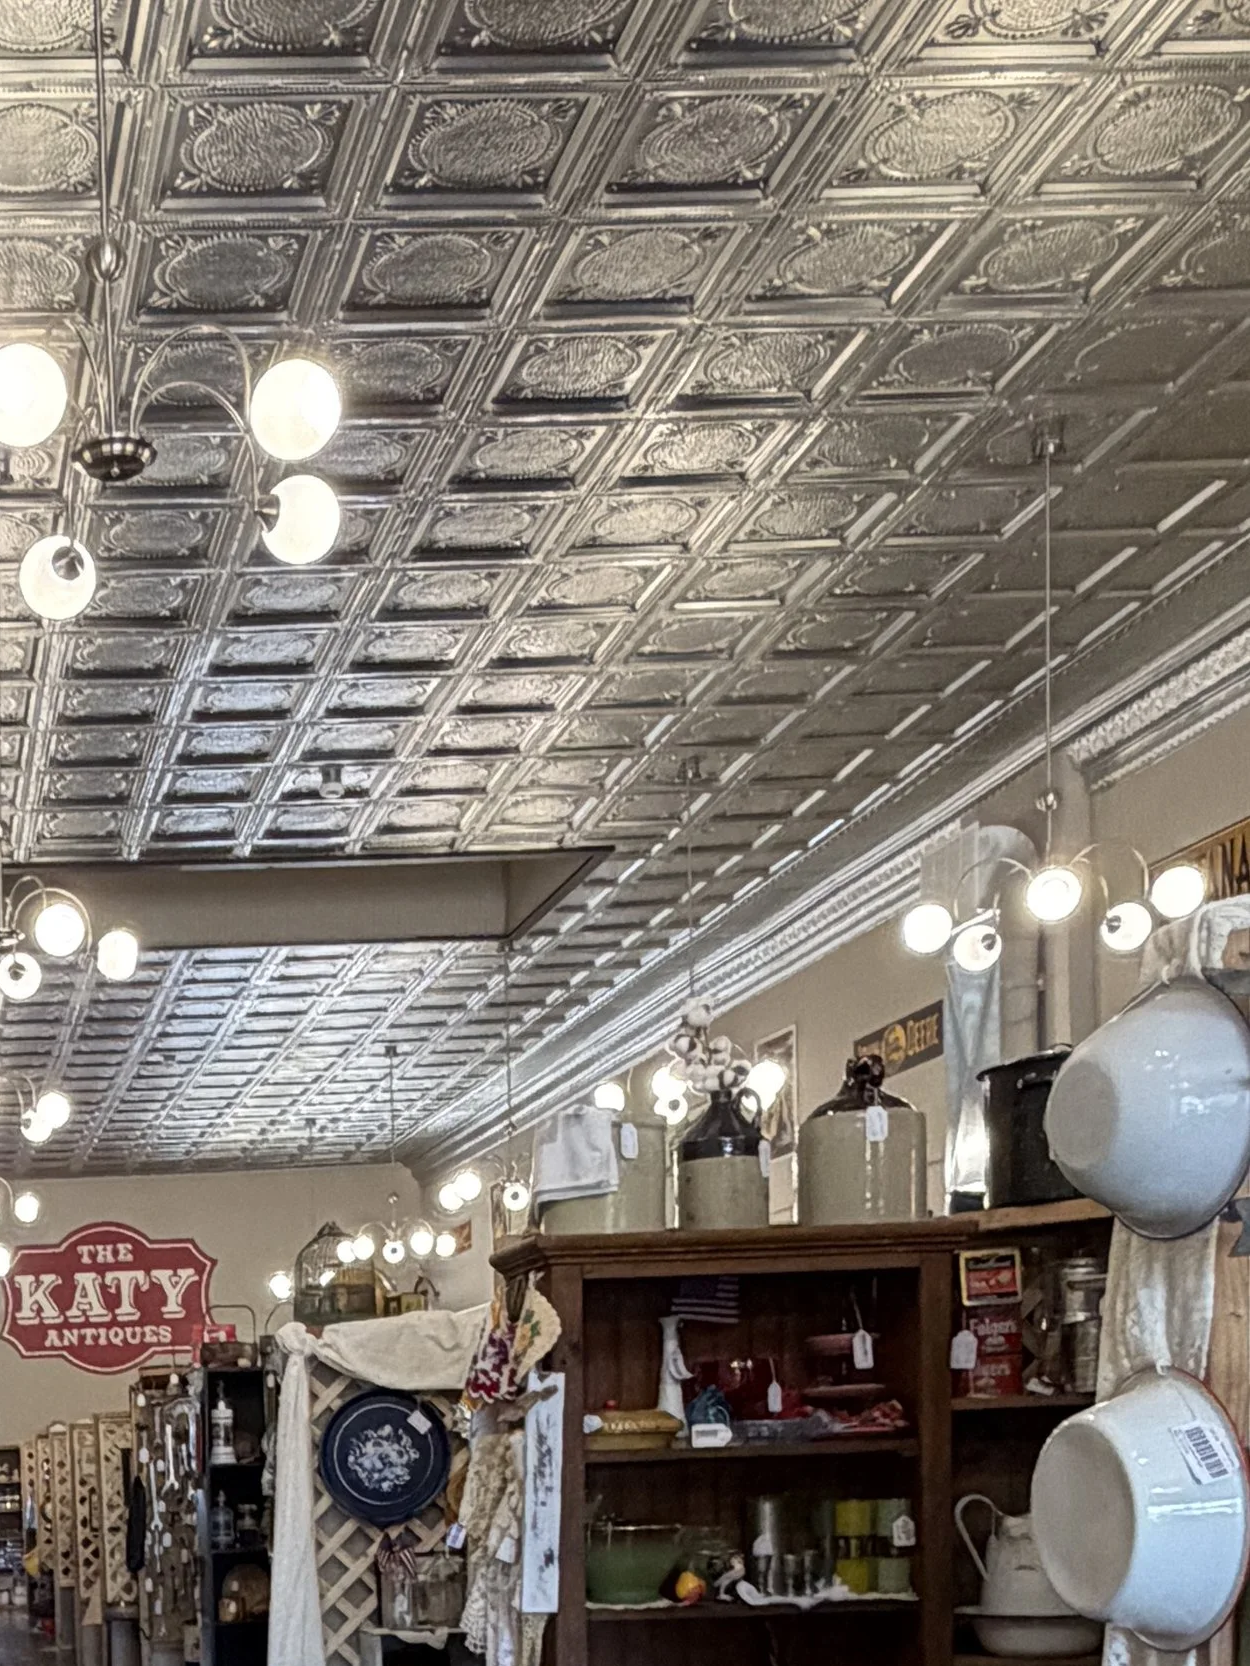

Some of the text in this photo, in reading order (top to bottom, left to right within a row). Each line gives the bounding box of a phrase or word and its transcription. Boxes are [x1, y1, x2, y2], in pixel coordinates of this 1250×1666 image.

[77, 1243, 134, 1264] THE
[14, 1268, 199, 1325] KATY
[44, 1325, 172, 1347] ANTIQUES
